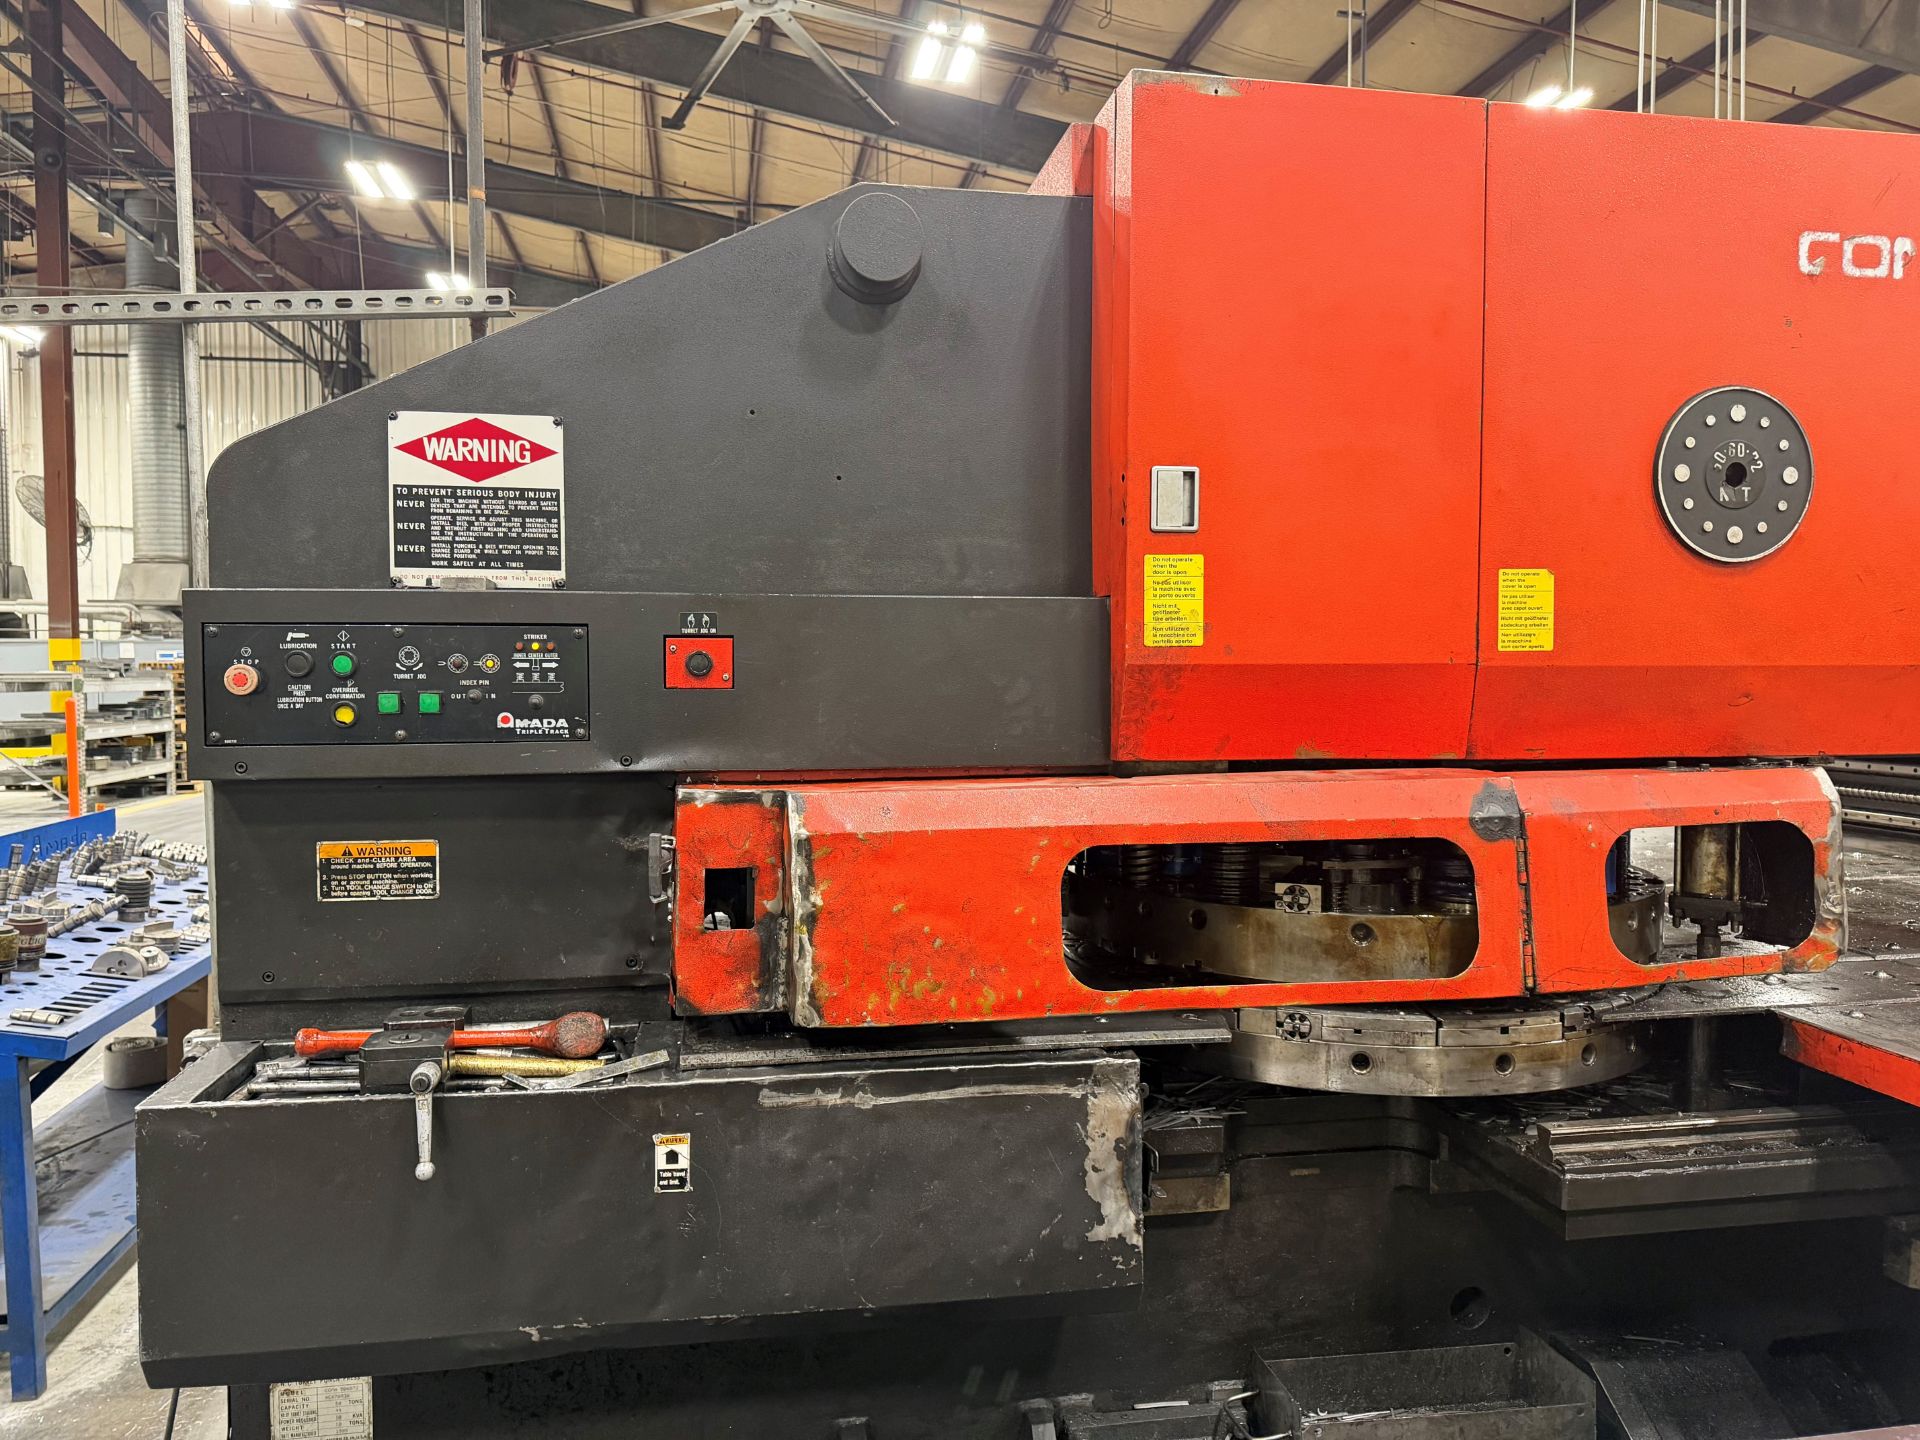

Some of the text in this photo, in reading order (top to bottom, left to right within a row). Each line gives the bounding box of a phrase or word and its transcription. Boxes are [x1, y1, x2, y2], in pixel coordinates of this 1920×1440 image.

[422, 437, 531, 464] WARNING
[497, 712, 568, 728] AMADA
[356, 846, 411, 856] WARNING
